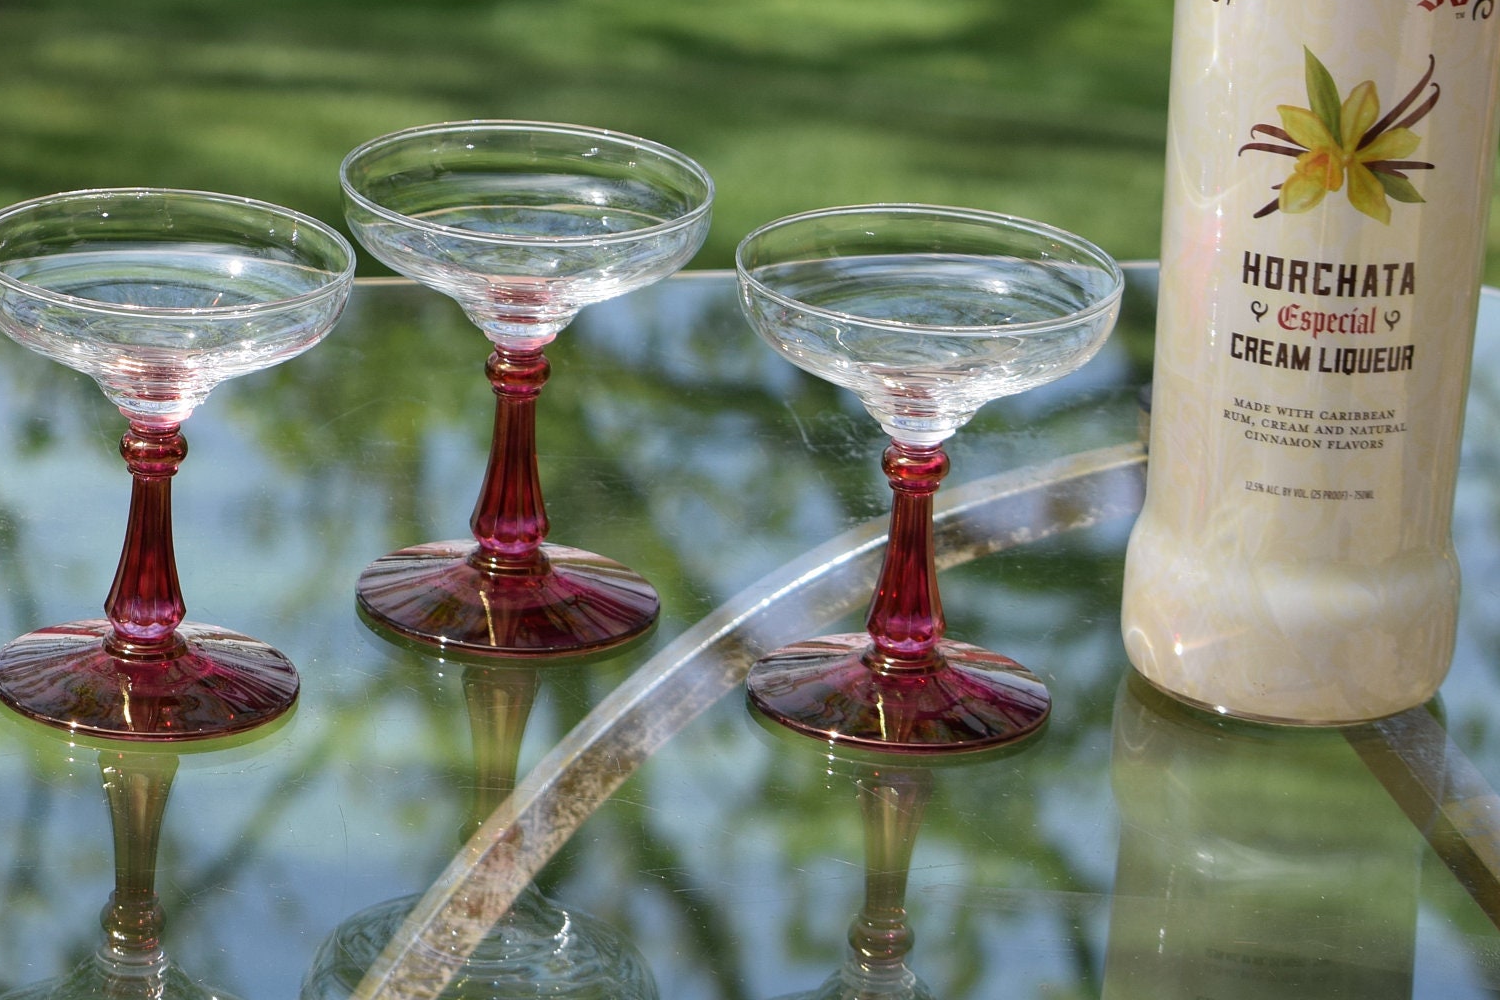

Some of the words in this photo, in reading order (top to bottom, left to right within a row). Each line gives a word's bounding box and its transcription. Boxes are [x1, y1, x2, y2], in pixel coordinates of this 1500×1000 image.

[1242, 250, 1415, 297] HORCHATA
[1277, 303, 1377, 339] Especial
[1230, 332, 1311, 371] CREAM
[1318, 344, 1415, 375] LIQUEUR
[1223, 409, 1256, 427] RUM,
[1261, 418, 1309, 433] CREAM
[1314, 426, 1344, 435] AND
[1350, 423, 1407, 435] NATURAL
[1234, 397, 1271, 414] MADE
[1276, 406, 1314, 419] WITH
[1319, 409, 1396, 421] CARIBBEAN
[1244, 429, 1322, 449] CINNAMON
[1327, 439, 1384, 450] FLAVORS
[1282, 487, 1292, 497] BY
